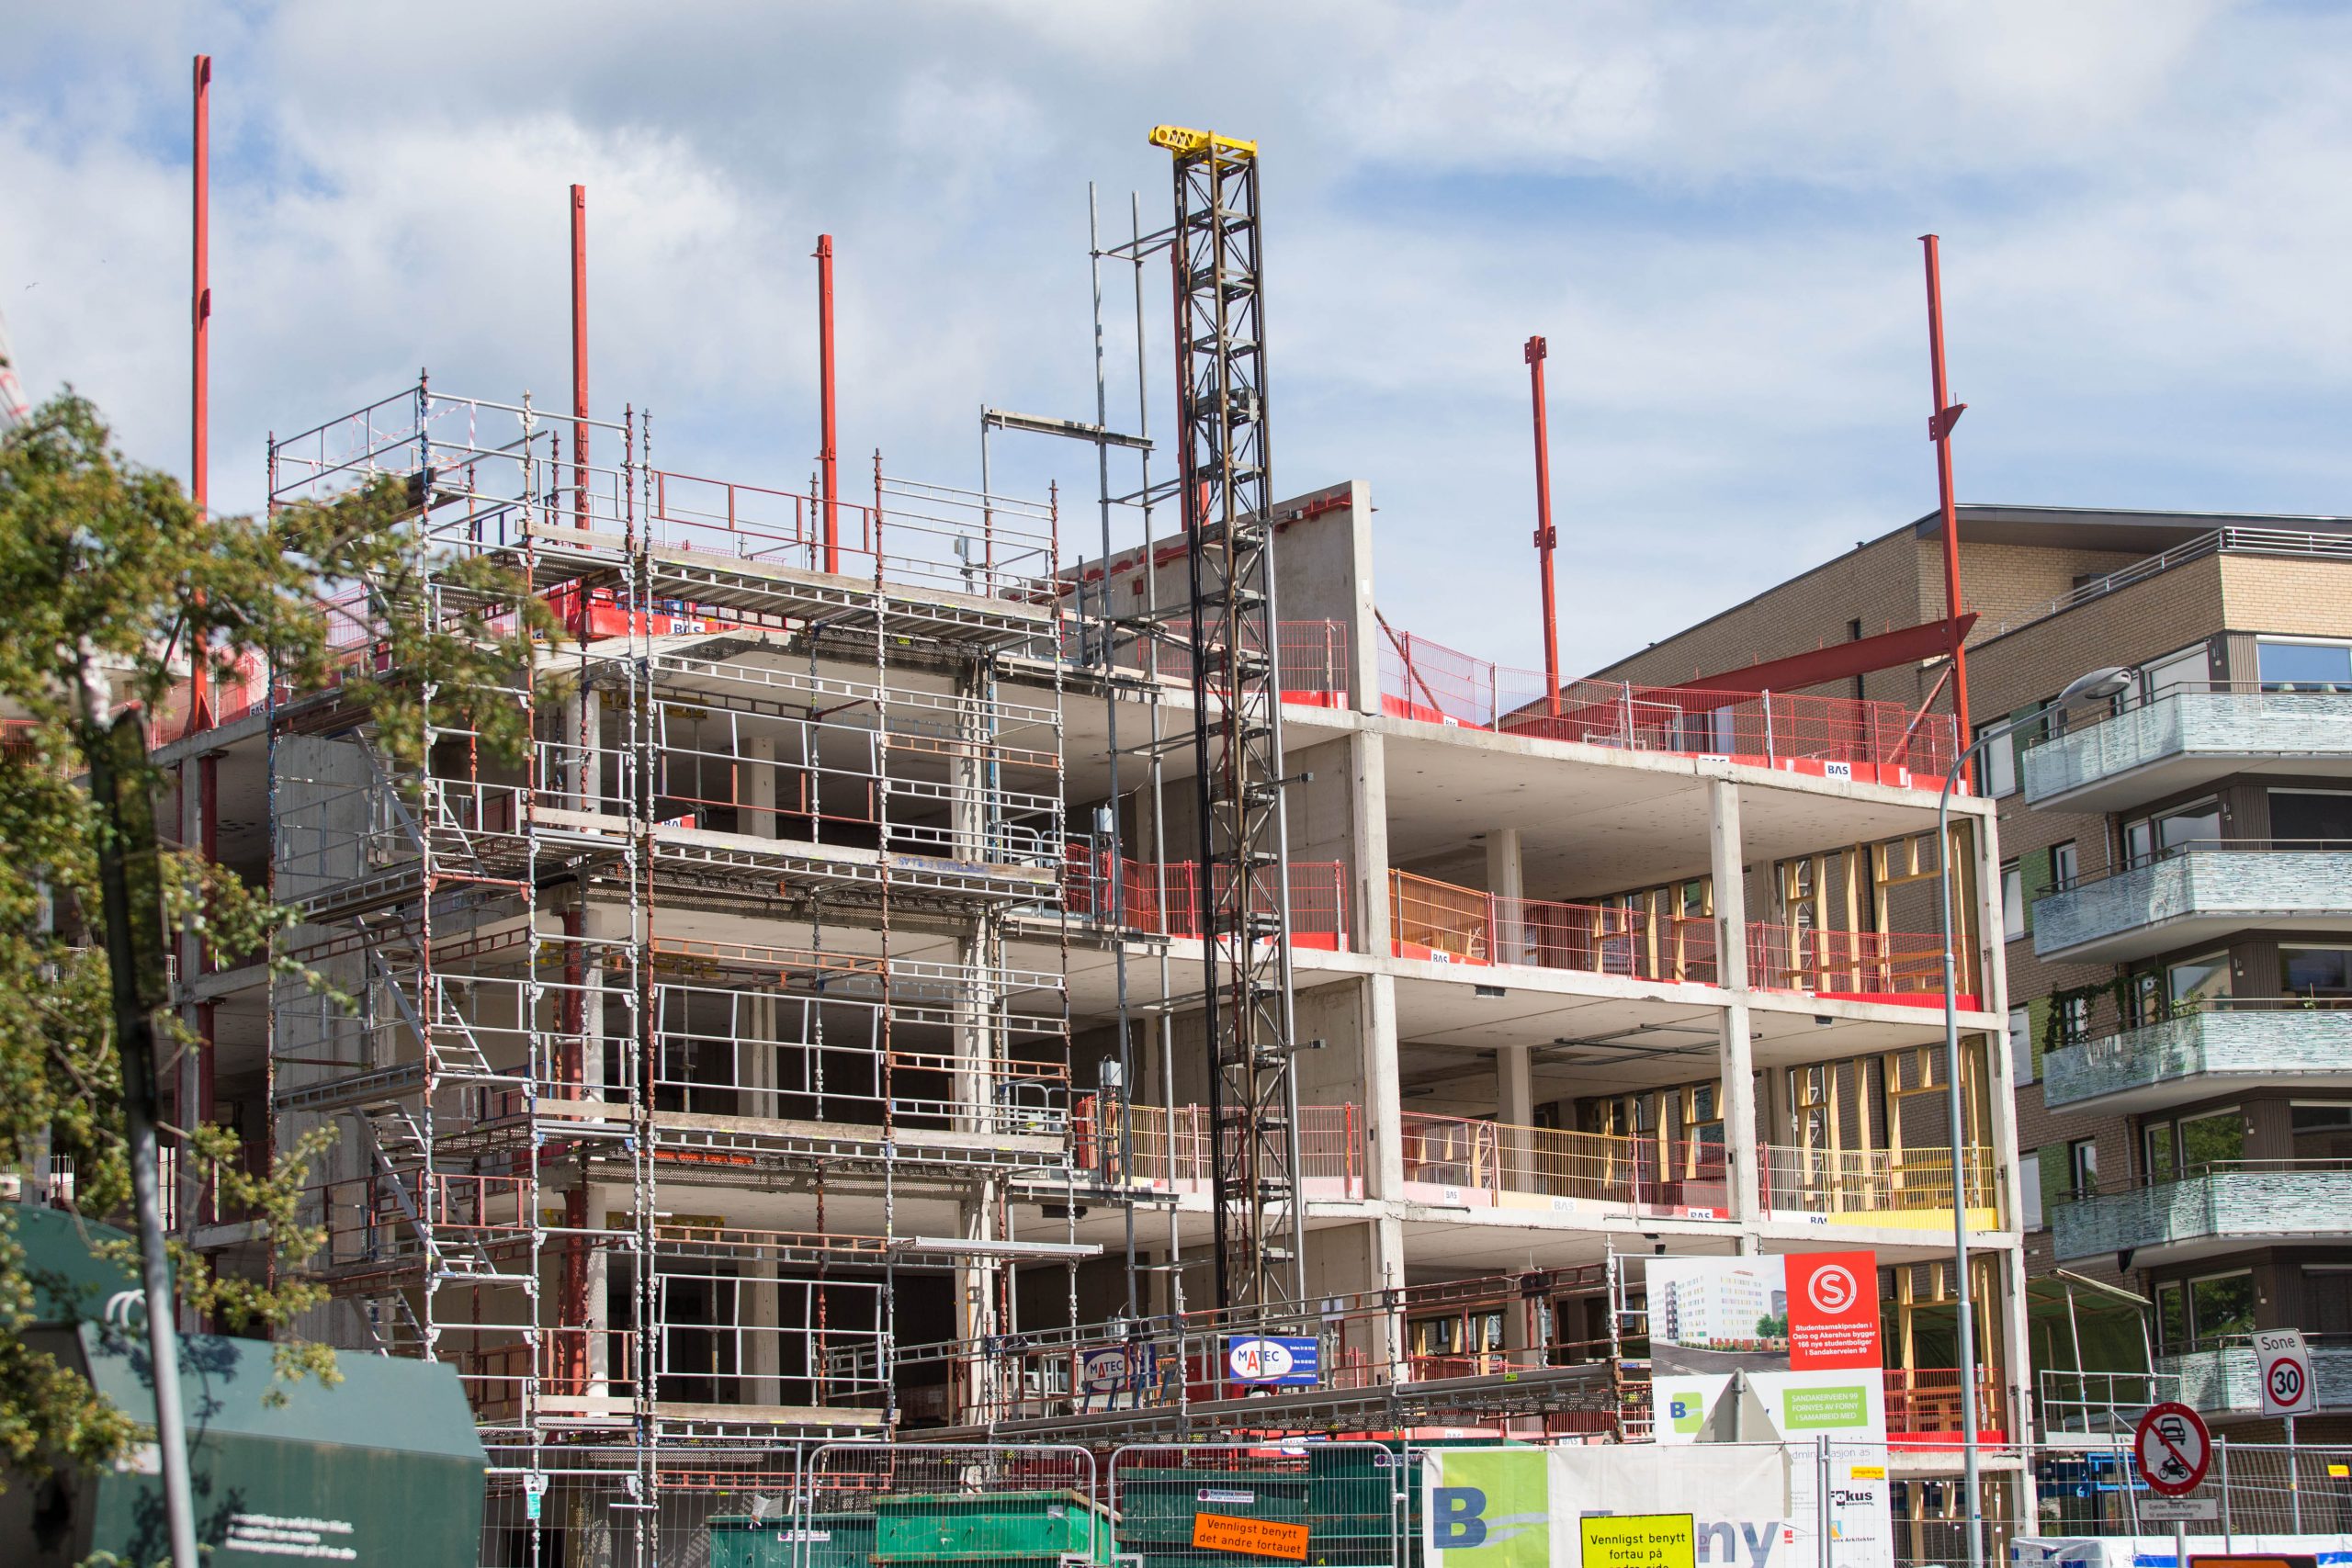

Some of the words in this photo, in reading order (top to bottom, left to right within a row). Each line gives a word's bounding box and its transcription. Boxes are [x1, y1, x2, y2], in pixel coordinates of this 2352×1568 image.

[1827, 764, 1849, 775] BAS
[1432, 953, 1448, 964] BAS
[1445, 1190, 1457, 1200] BAS
[1554, 1201, 1574, 1212] BAS
[1821, 1274, 1844, 1304] S
[1795, 1323, 1869, 1331] Studentsamskipnaden
[1852, 1330, 1876, 1338] bygger
[1825, 1338, 1872, 1347] studentboliger
[2261, 1336, 2296, 1350] Sone
[1809, 1348, 1858, 1356] Sandakerveien
[1238, 1349, 1280, 1371] MATEC
[1090, 1359, 1124, 1378] MATEC
[2274, 1370, 2299, 1395] 30
[1792, 1393, 1849, 1403] SANDAKERVEIEN
[1670, 1402, 1686, 1418] B
[1792, 1404, 1824, 1412] FORNYES
[1800, 1413, 1838, 1421] SAMARBEID
[1792, 1450, 1856, 1460] dminasjon
[1433, 1487, 1487, 1549] B
[1207, 1518, 1257, 1535] Vennligst
[1261, 1526, 1297, 1540] benytt
[1199, 1533, 1216, 1543] det
[1221, 1537, 1252, 1548] andre
[1257, 1540, 1301, 1554] fortauet
[1590, 1533, 1644, 1546] Vennligst
[1649, 1533, 1685, 1545] benytt
[1610, 1549, 1644, 1560] fortau
[1649, 1548, 1663, 1561] på
